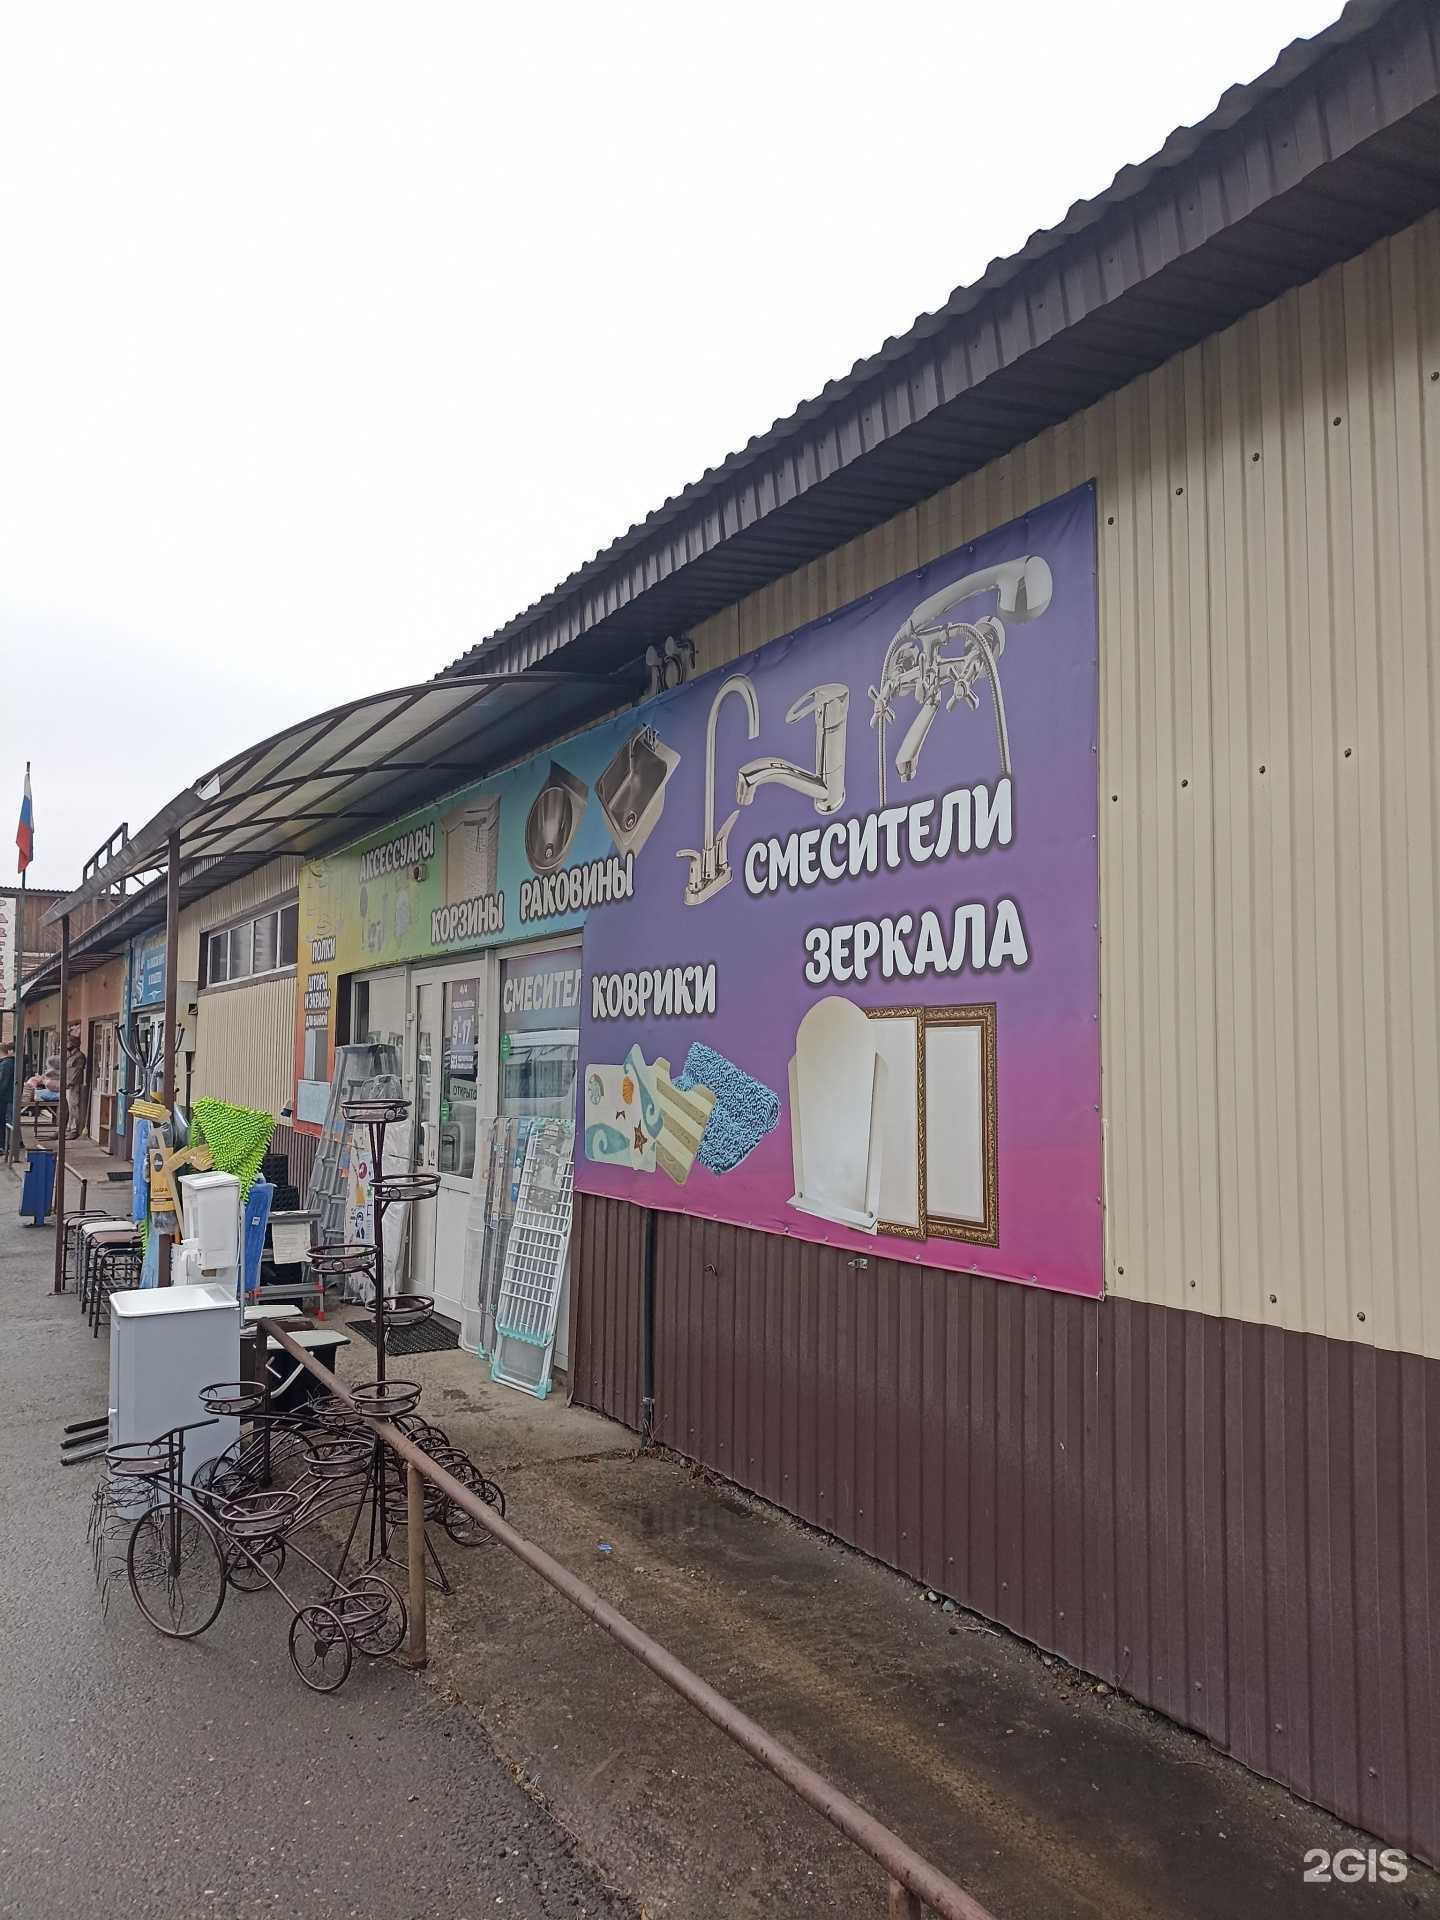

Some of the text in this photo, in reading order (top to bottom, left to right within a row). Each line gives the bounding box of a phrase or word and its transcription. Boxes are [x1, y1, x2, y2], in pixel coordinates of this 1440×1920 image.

[360, 824, 435, 882] АКСЕССУАРЫ
[744, 778, 1013, 895] СМЕСИТЕЛИ
[521, 852, 635, 920] РАКОВИНЫ
[431, 893, 504, 943] КОРЗИНЫ
[804, 899, 1028, 984] ЗЕРКАЛА
[312, 937, 336, 963] ПОЛКИ
[592, 964, 717, 1018] КОВРИКИ
[453, 1085, 477, 1101] ОТКРЫТО
